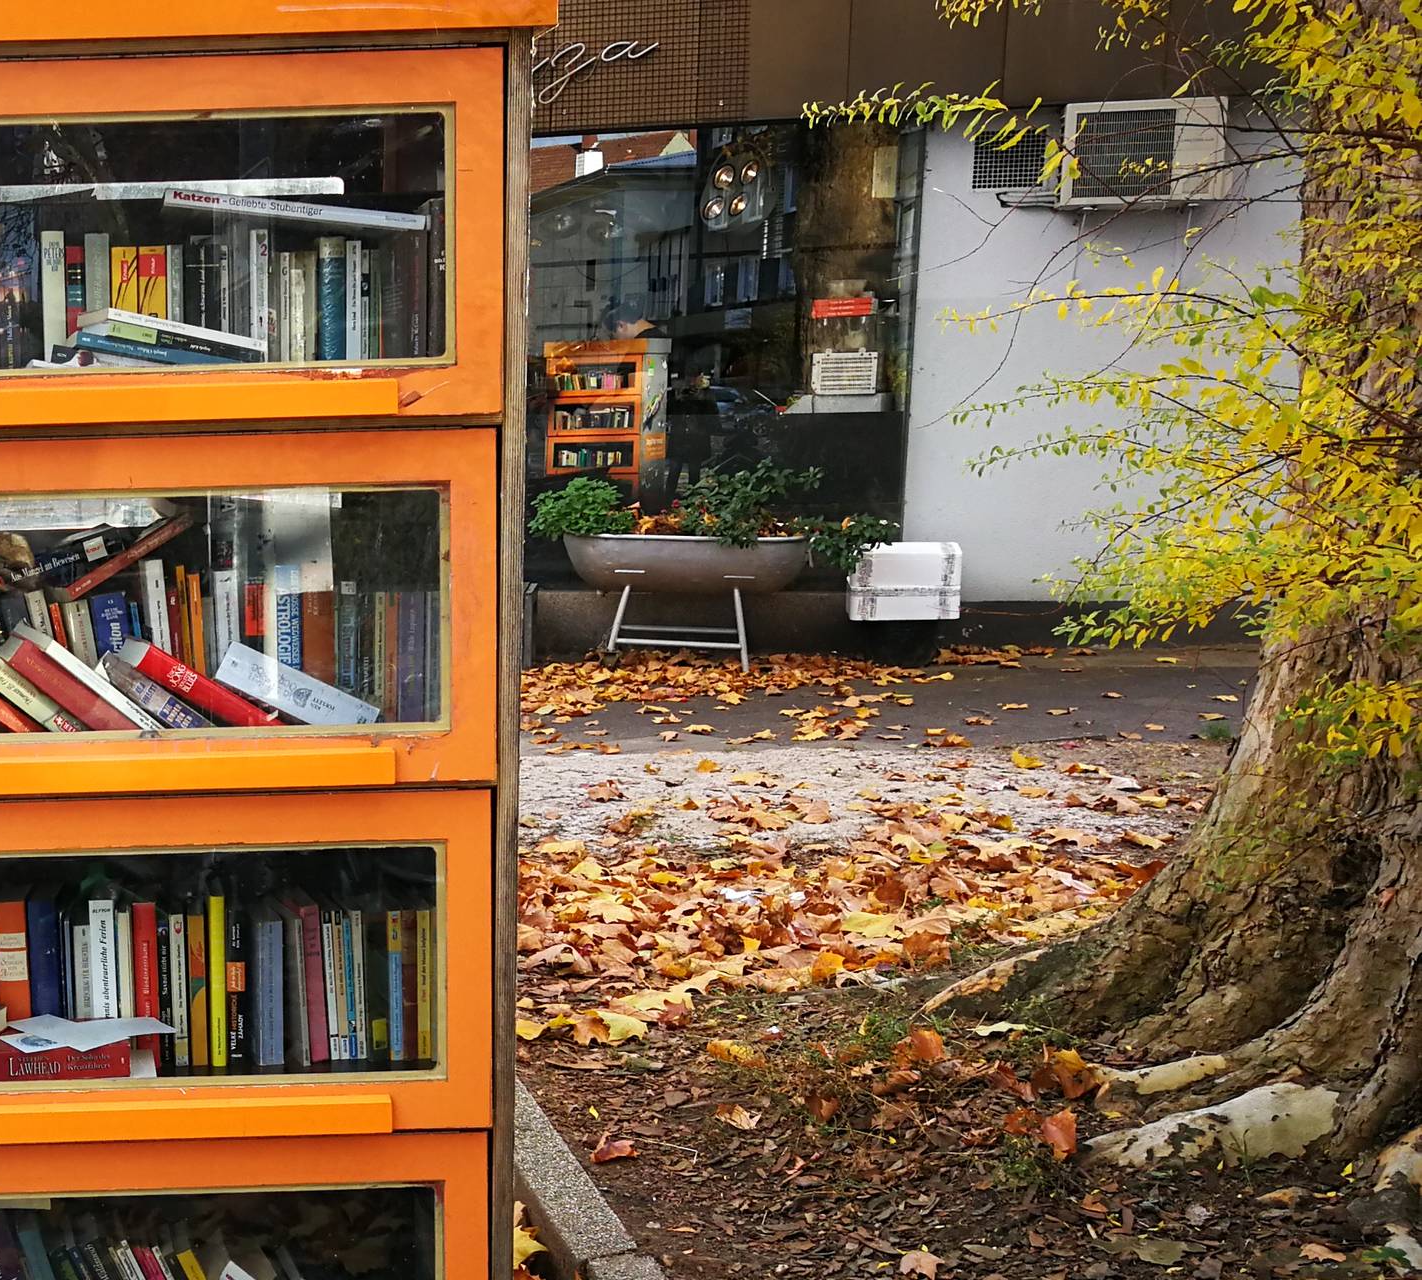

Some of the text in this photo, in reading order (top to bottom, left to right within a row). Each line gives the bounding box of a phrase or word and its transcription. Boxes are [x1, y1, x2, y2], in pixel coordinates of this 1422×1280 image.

[173, 190, 323, 216] Katzen Geliebte Stubentiger
[51, 549, 80, 568] Beweisen
[167, 663, 188, 687] JONG
[95, 919, 109, 944] Ferien
[96, 946, 113, 1000] abenteuerliche
[9, 1057, 60, 1076] LAWHEAD
